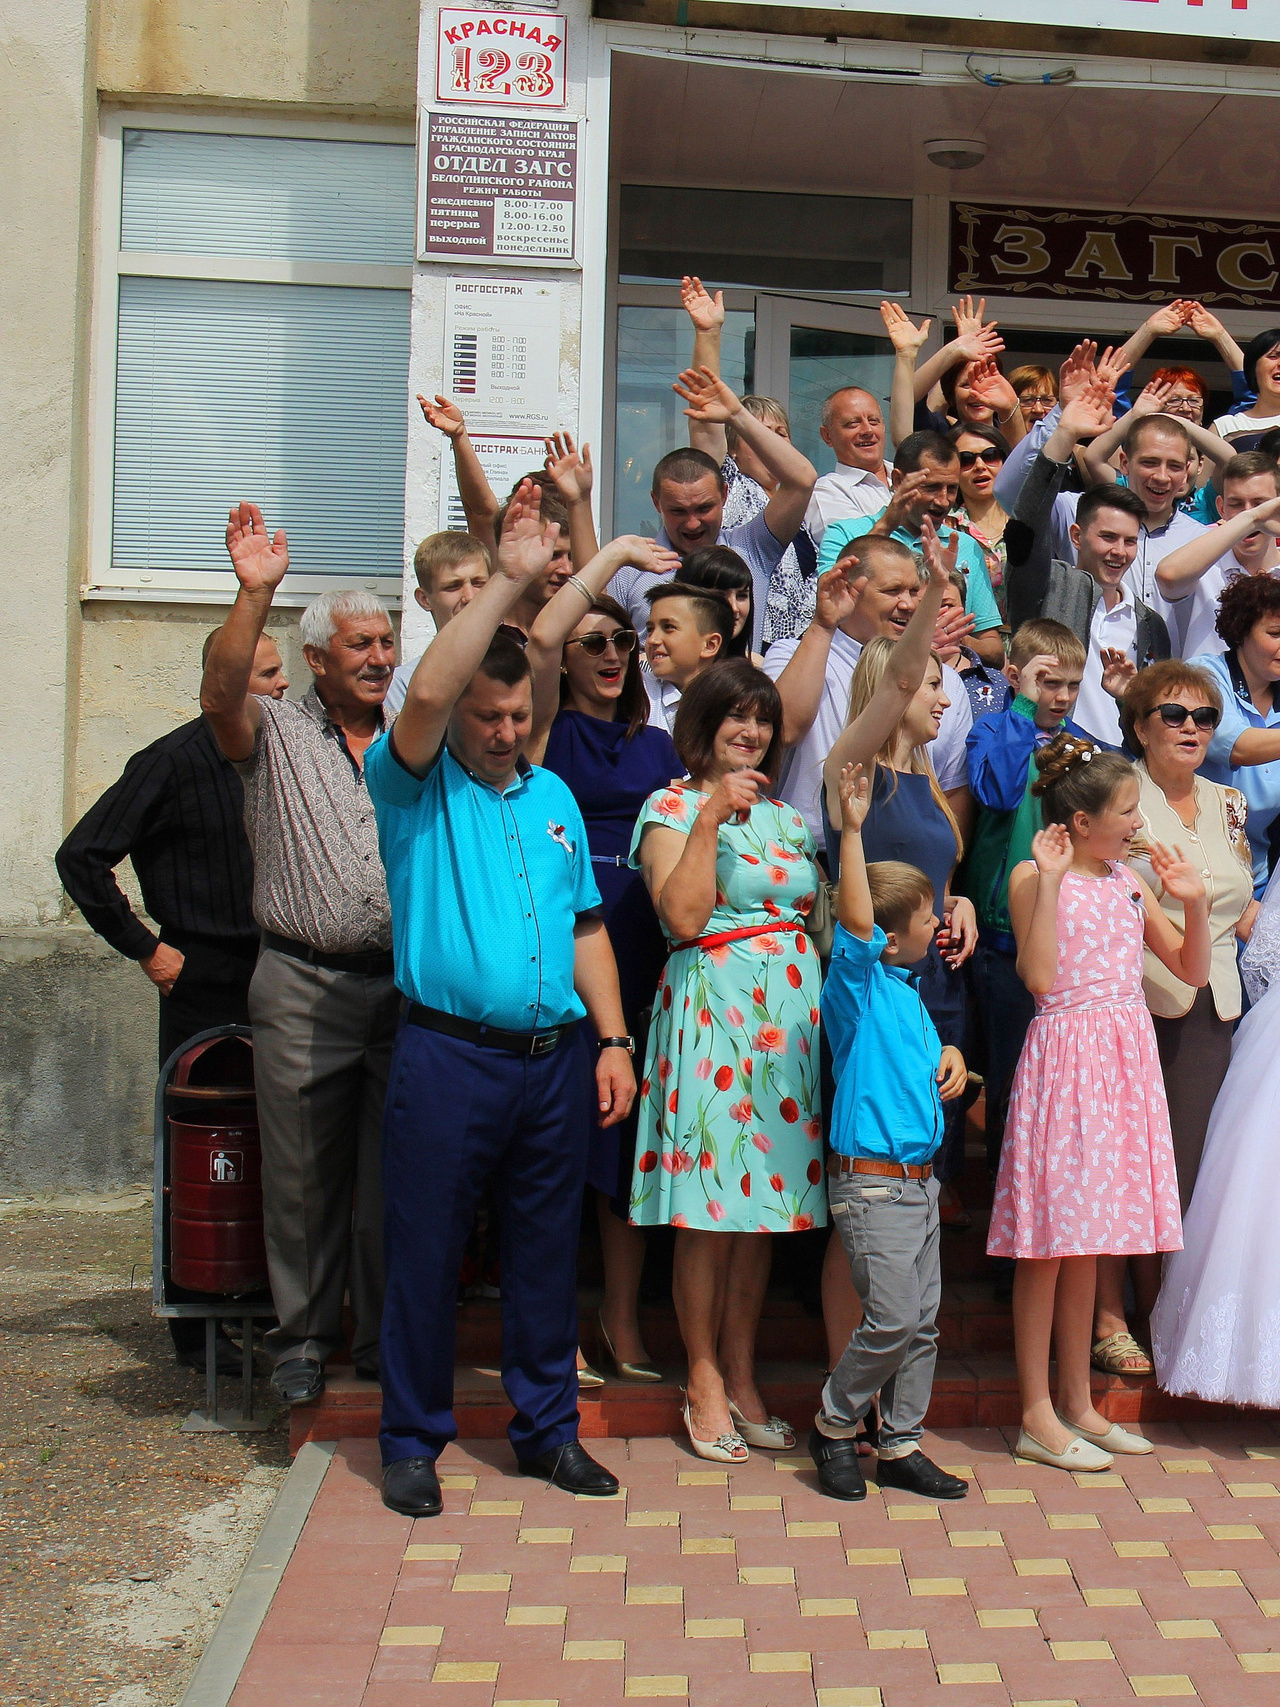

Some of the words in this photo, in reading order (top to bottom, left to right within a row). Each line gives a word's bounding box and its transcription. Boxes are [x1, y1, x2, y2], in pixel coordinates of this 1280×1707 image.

[444, 19, 562, 52] КРАСНАЯ
[451, 46, 554, 97] 123
[438, 116, 506, 128] РОССИЙСКАЯ
[509, 120, 570, 132] ФЕДЕРАЦИЯ
[431, 125, 497, 136] УПРАВЛЕНИЕ
[500, 129, 540, 139] ЗАПИСИ
[543, 132, 577, 141] АКТОВ
[431, 134, 513, 146] ГРАЖДАНСКОГО
[516, 139, 576, 150] СОСТОЯНИЯ
[441, 144, 535, 157] КРАСНОДАРСКОГО
[538, 150, 566, 159] КРАЯ
[433, 155, 507, 174] ОТДЕЛ
[514, 159, 572, 177] ЗАГС
[431, 173, 525, 186] БЕЛОГЛИНСКОГО
[528, 178, 574, 189] РАЙОНА
[463, 186, 499, 195] РЕЖИМ
[502, 188, 542, 197] РАБОТЫ
[430, 197, 494, 208] ежедневно
[503, 200, 563, 210] 8.00-17.00
[430, 208, 479, 218] пятница
[503, 211, 563, 221] 8.00-16.00
[430, 219, 481, 230] перерыв
[500, 222, 566, 233] 12.00-12.50
[429, 235, 487, 245] выходной
[496, 234, 569, 244] воскресенье
[496, 244, 570, 254] понедельник
[991, 223, 1279, 292] ЗАГС
[455, 284, 523, 295] РОСГОССТРАХ
[508, 413, 549, 421] www.RGS.ru
[450, 444, 519, 454] РОССТРАХ
[520, 446, 548, 456] БАНК
